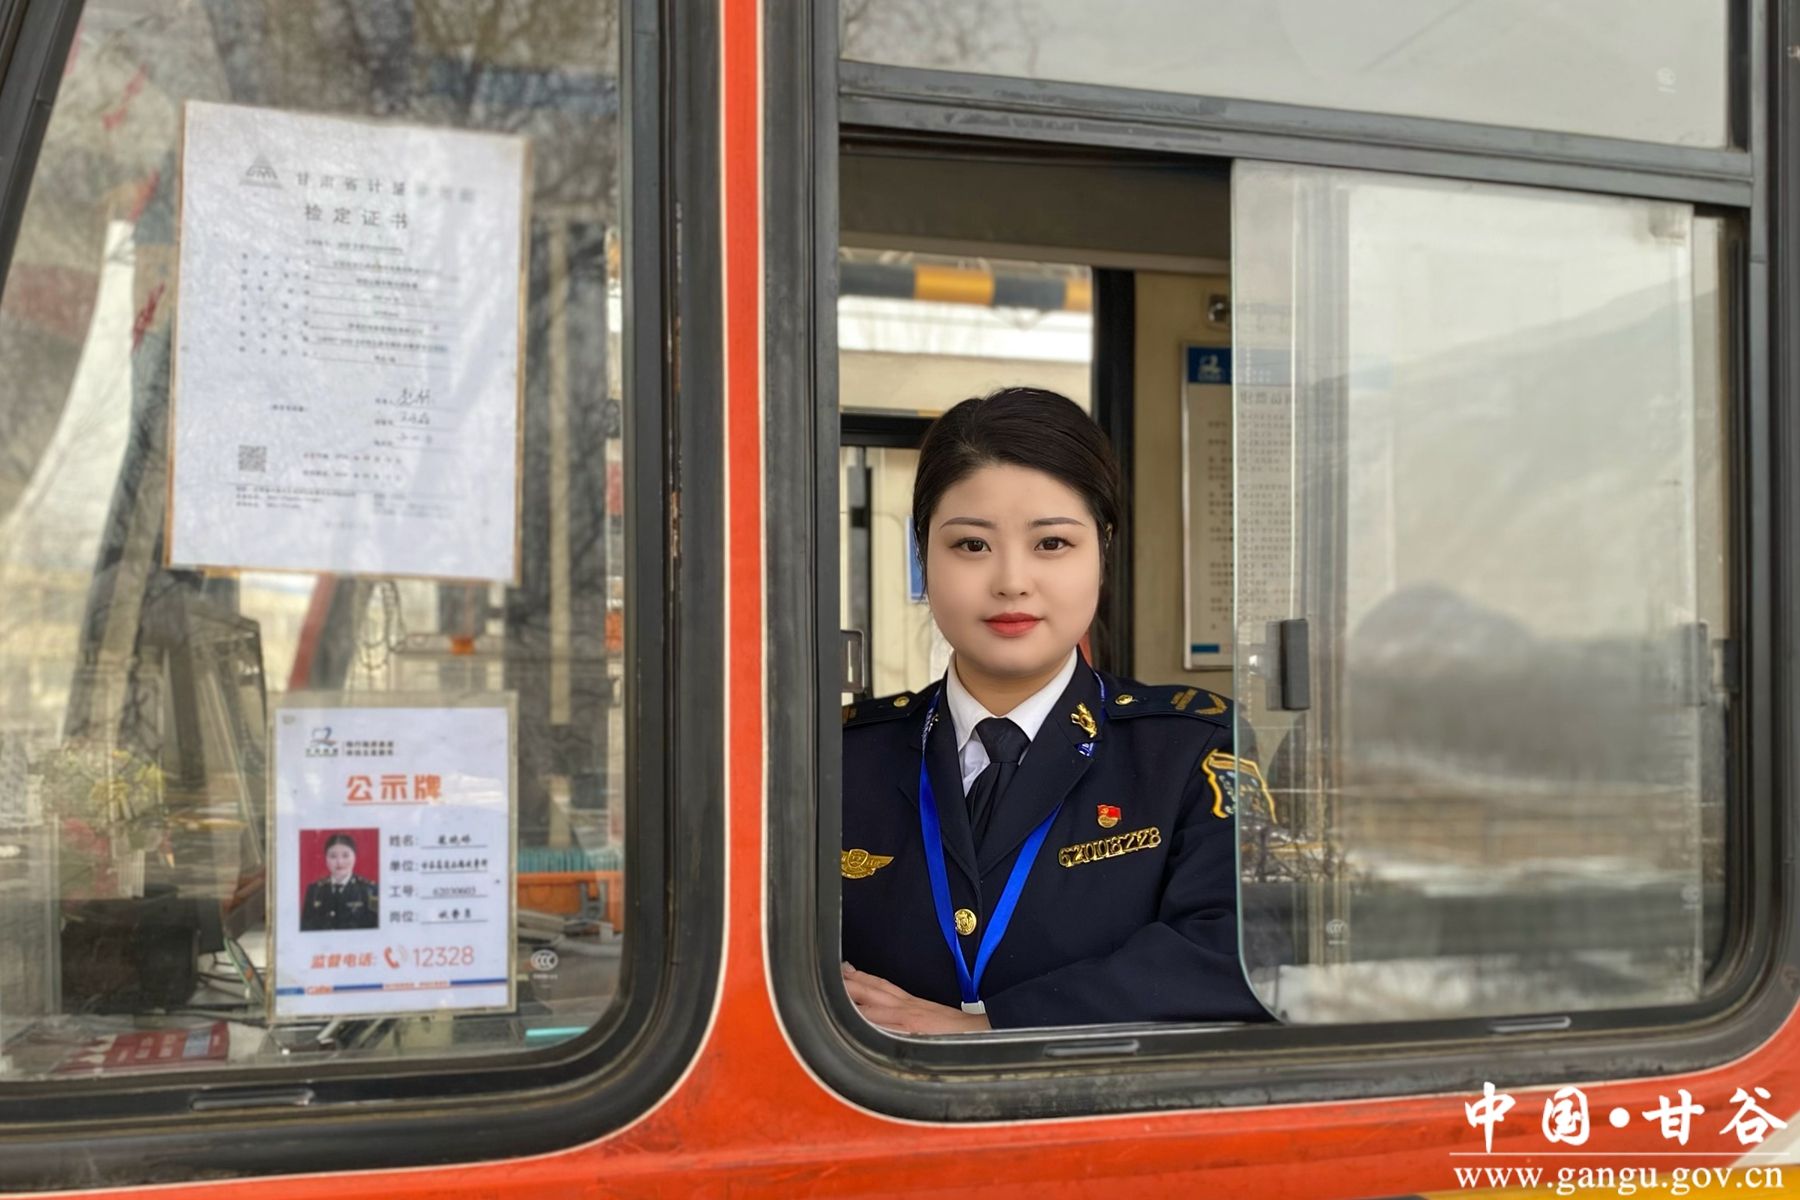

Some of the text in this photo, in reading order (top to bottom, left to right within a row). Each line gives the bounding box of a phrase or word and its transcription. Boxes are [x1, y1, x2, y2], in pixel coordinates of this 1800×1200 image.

[304, 204, 408, 229] 检定证书
[347, 774, 442, 801] 公示牌
[1059, 826, 1162, 868] 62008228
[413, 946, 475, 968] 12328
